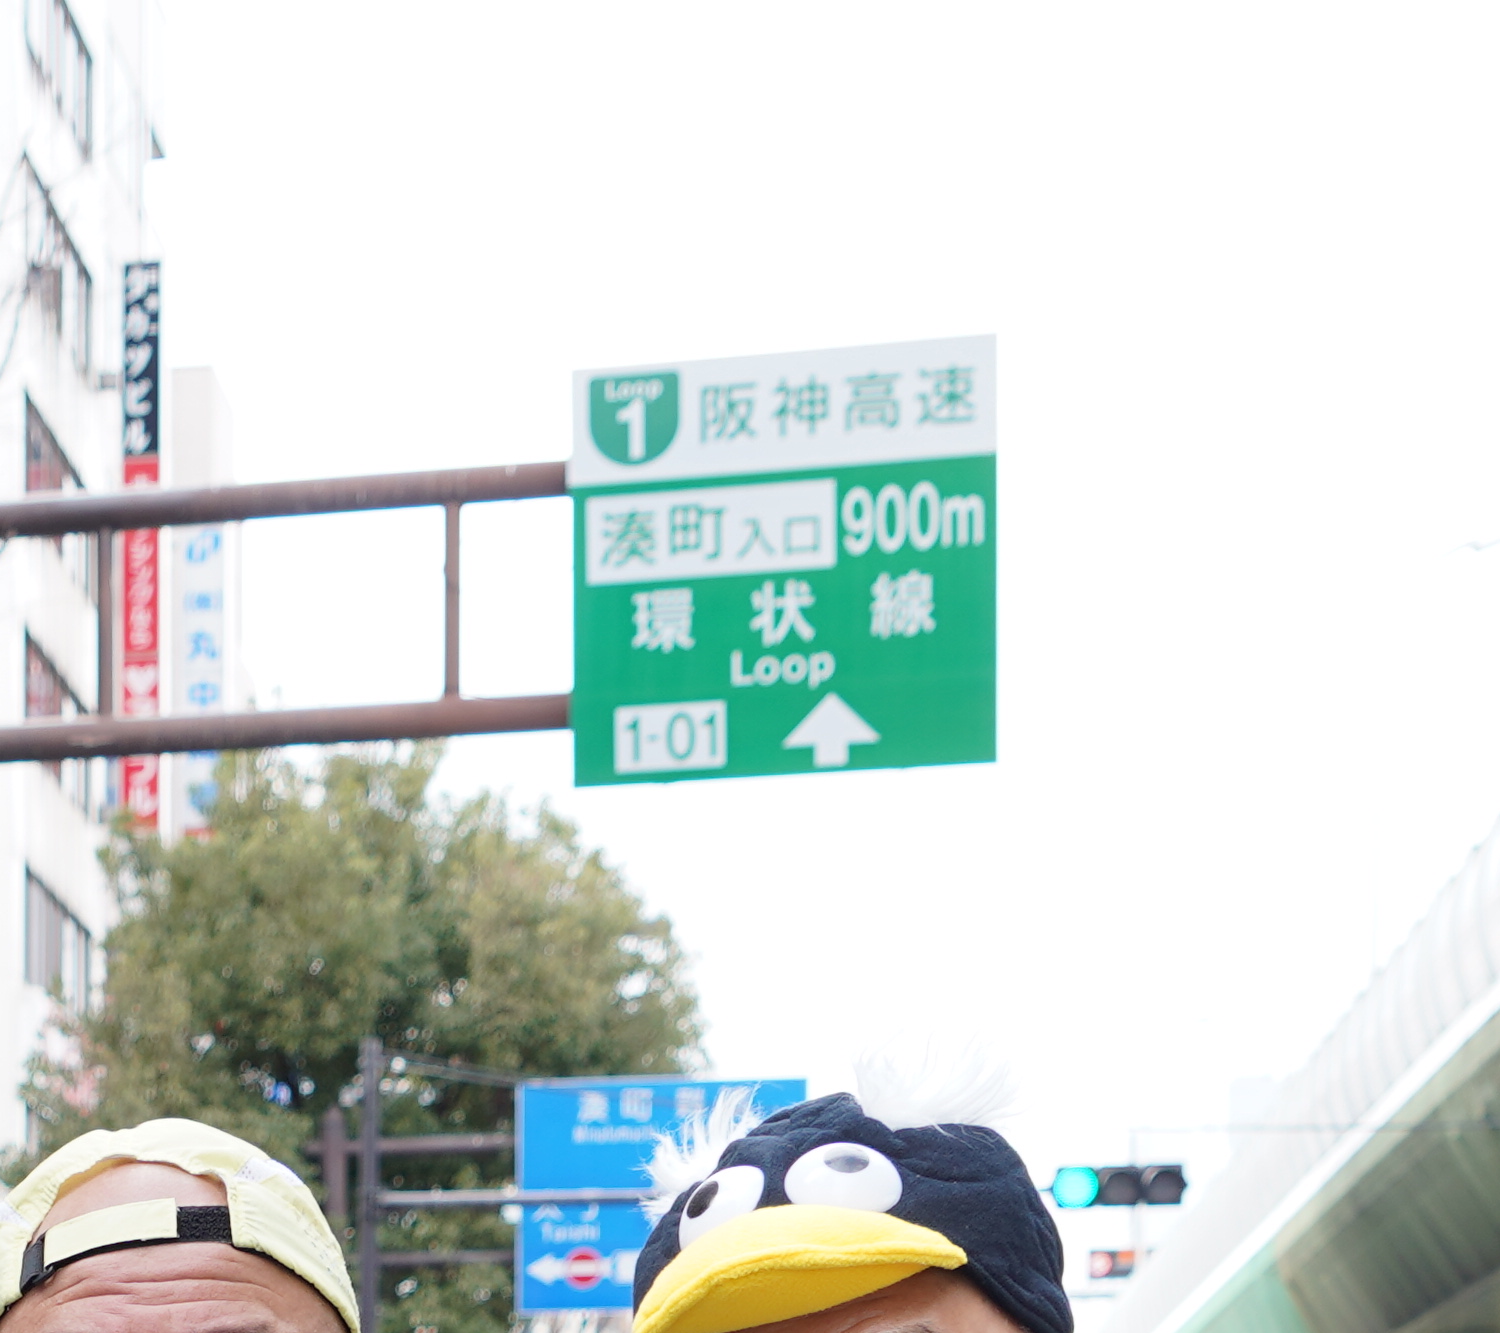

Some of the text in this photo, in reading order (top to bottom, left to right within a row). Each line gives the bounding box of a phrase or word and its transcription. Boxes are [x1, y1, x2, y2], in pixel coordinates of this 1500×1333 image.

[615, 399, 646, 460] 1
[699, 364, 977, 444] 阪神高速
[600, 480, 986, 569] 湊町入口 900m
[630, 569, 936, 654] 環状線
[730, 649, 836, 688] Loop
[622, 711, 722, 763] 1-01
